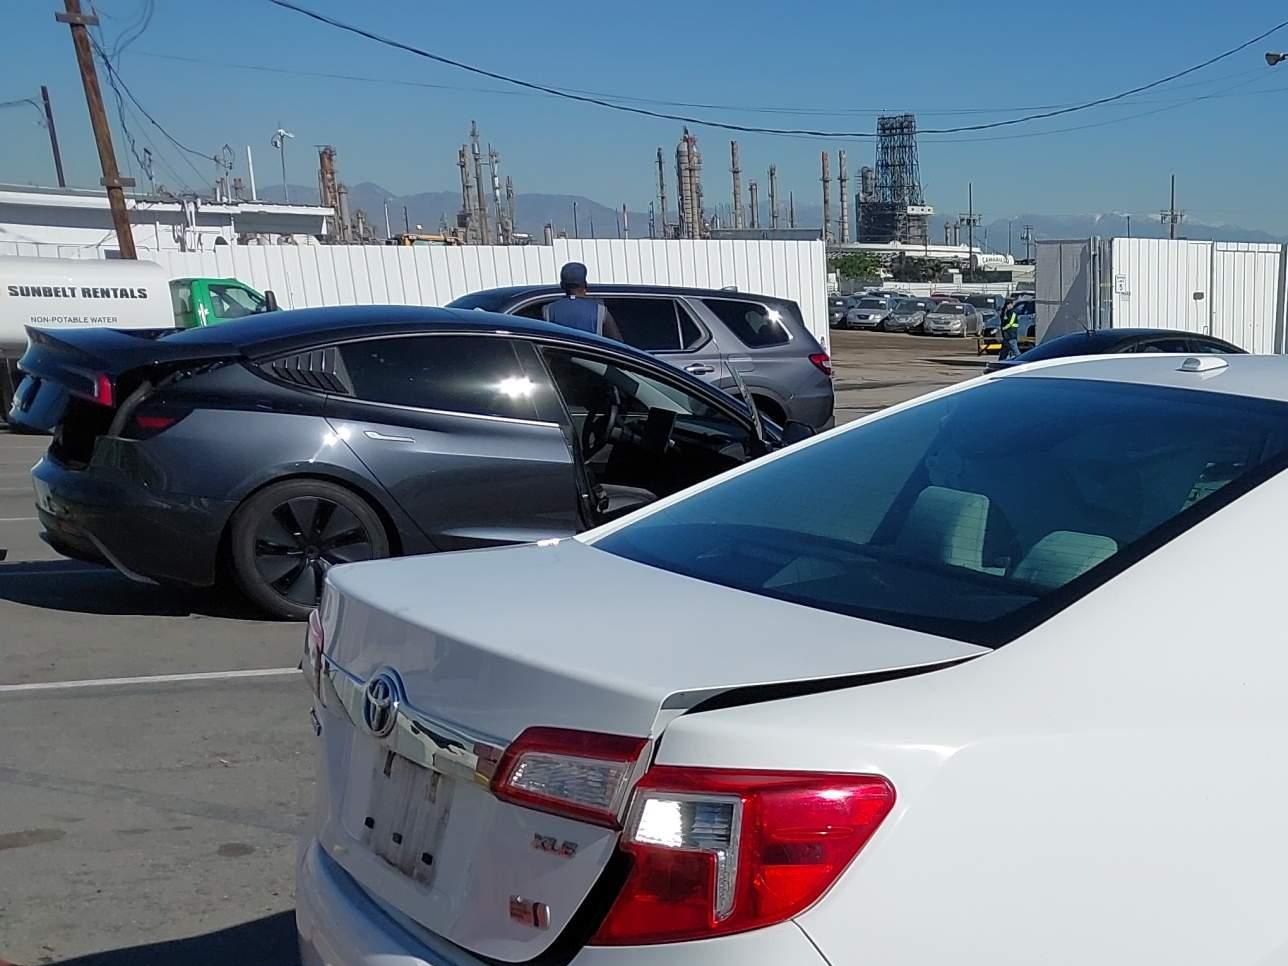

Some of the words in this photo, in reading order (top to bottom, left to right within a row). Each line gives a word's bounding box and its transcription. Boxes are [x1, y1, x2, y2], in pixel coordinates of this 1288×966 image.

[7, 285, 77, 298] SUNBELT
[82, 287, 148, 299] RENTALS
[30, 316, 88, 324] NON-POTABLE
